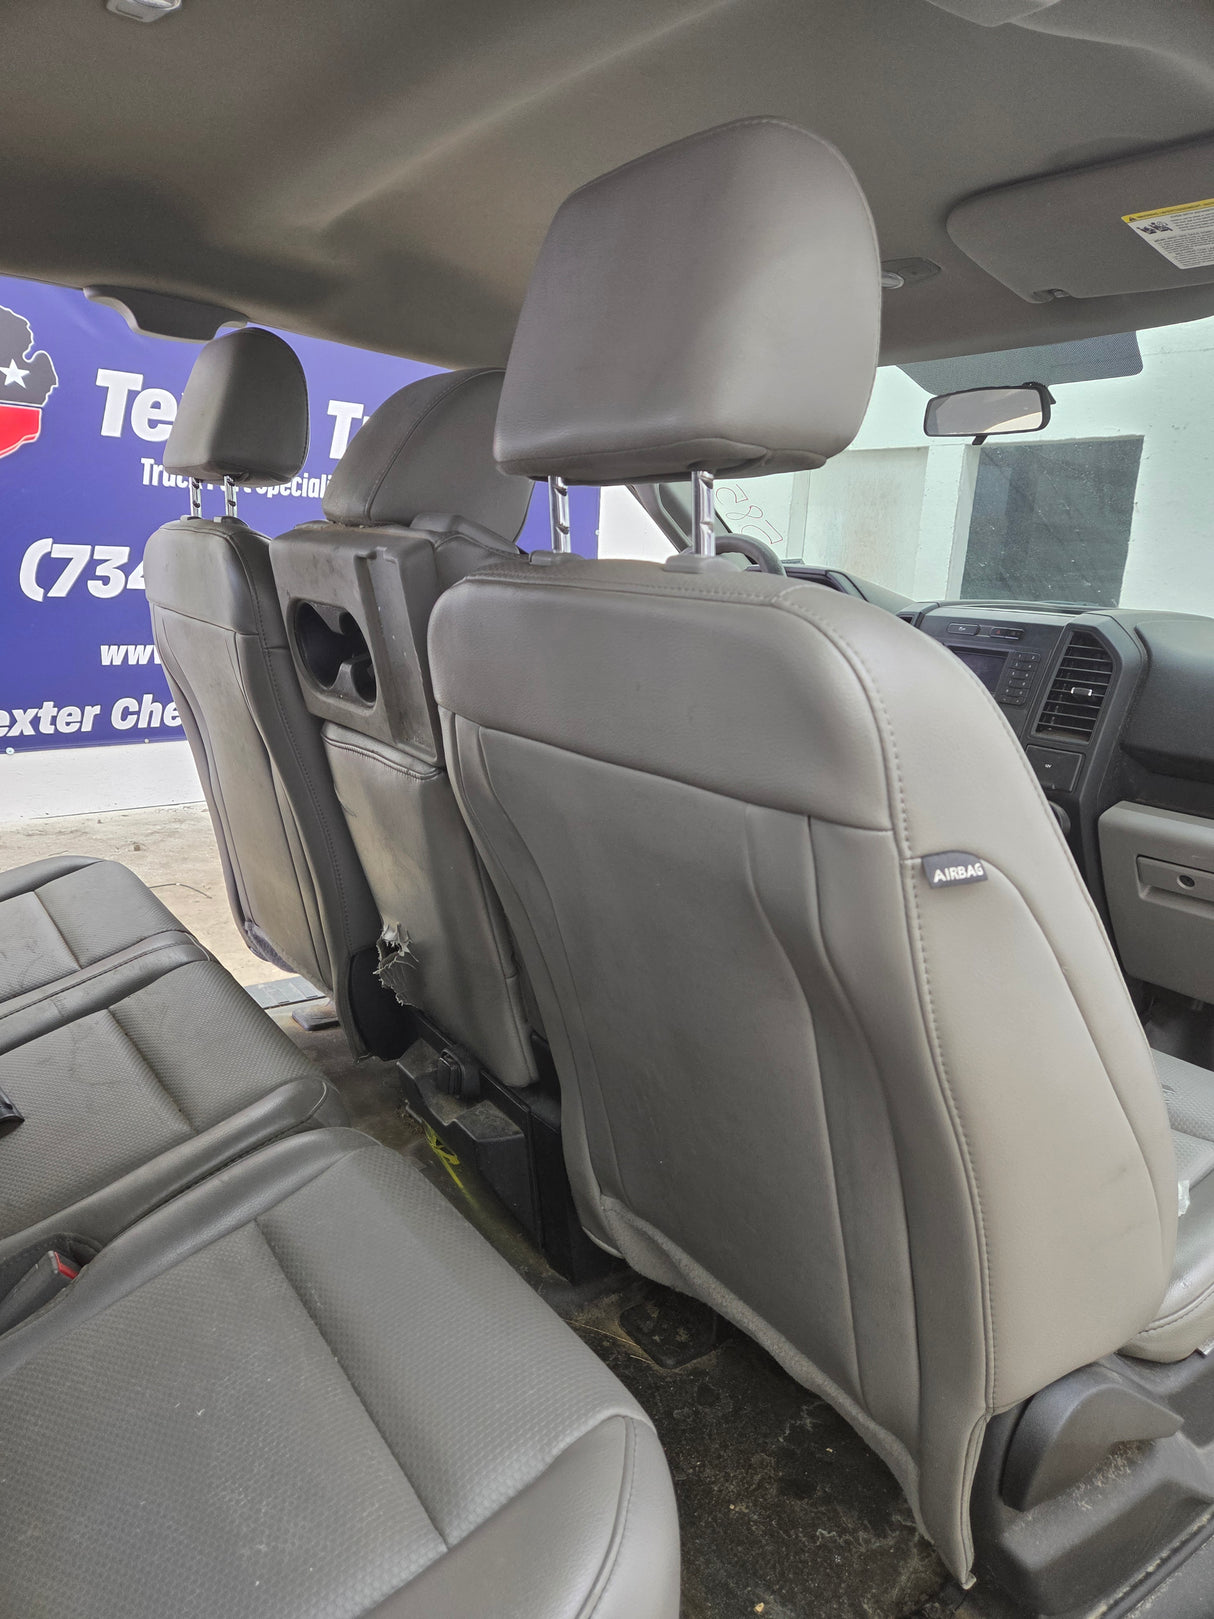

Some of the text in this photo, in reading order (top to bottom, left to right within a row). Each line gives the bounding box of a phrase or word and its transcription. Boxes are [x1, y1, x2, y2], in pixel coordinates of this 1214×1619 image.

[96, 368, 184, 442] Te
[141, 457, 203, 489] Truc
[0, 694, 183, 737] exter Che
[933, 862, 984, 883] AIRBAG
